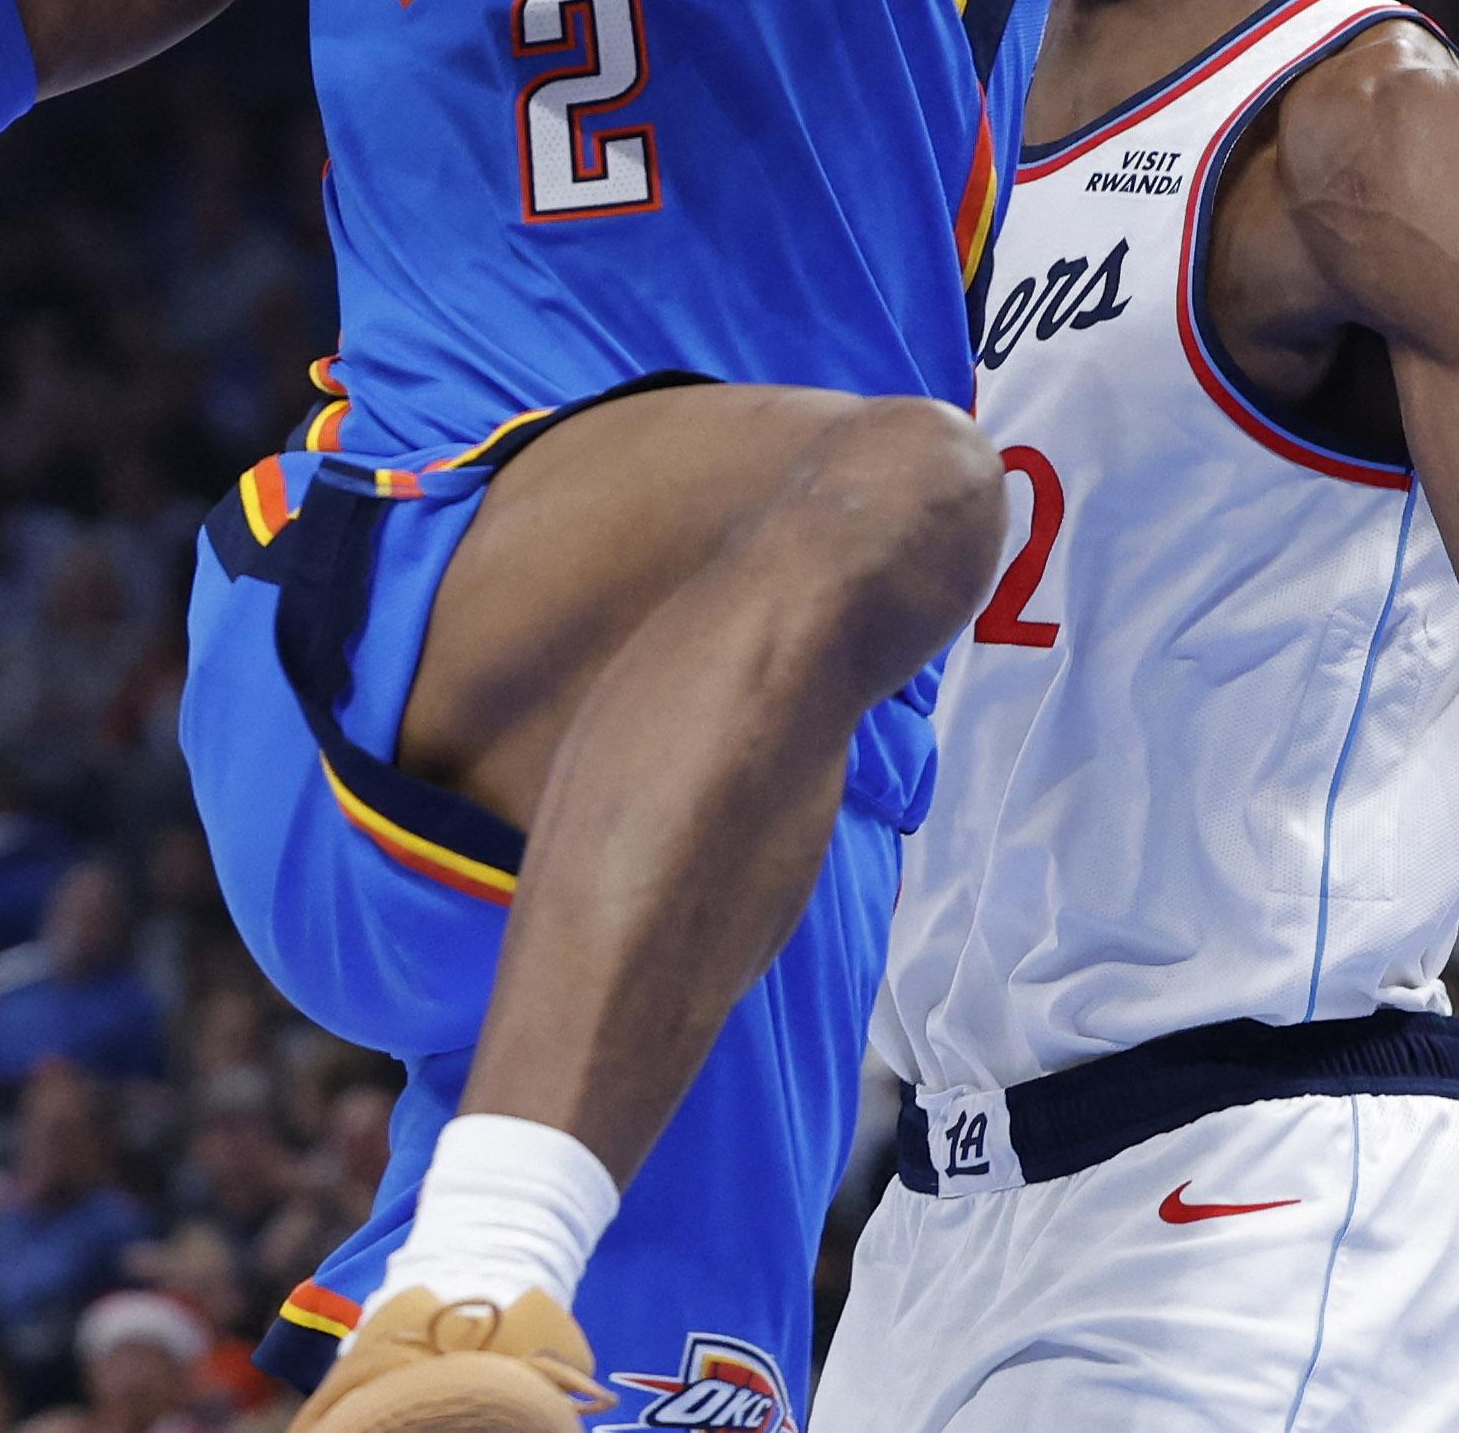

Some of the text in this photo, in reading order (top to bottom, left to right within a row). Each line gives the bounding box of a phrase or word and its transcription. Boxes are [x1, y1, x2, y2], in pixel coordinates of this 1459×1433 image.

[1084, 172, 1184, 196] RWANDA
[1121, 149, 1182, 172] VISIT
[973, 444, 1066, 649] 2
[944, 1109, 991, 1177] LA
[650, 1377, 774, 1428] OKC
